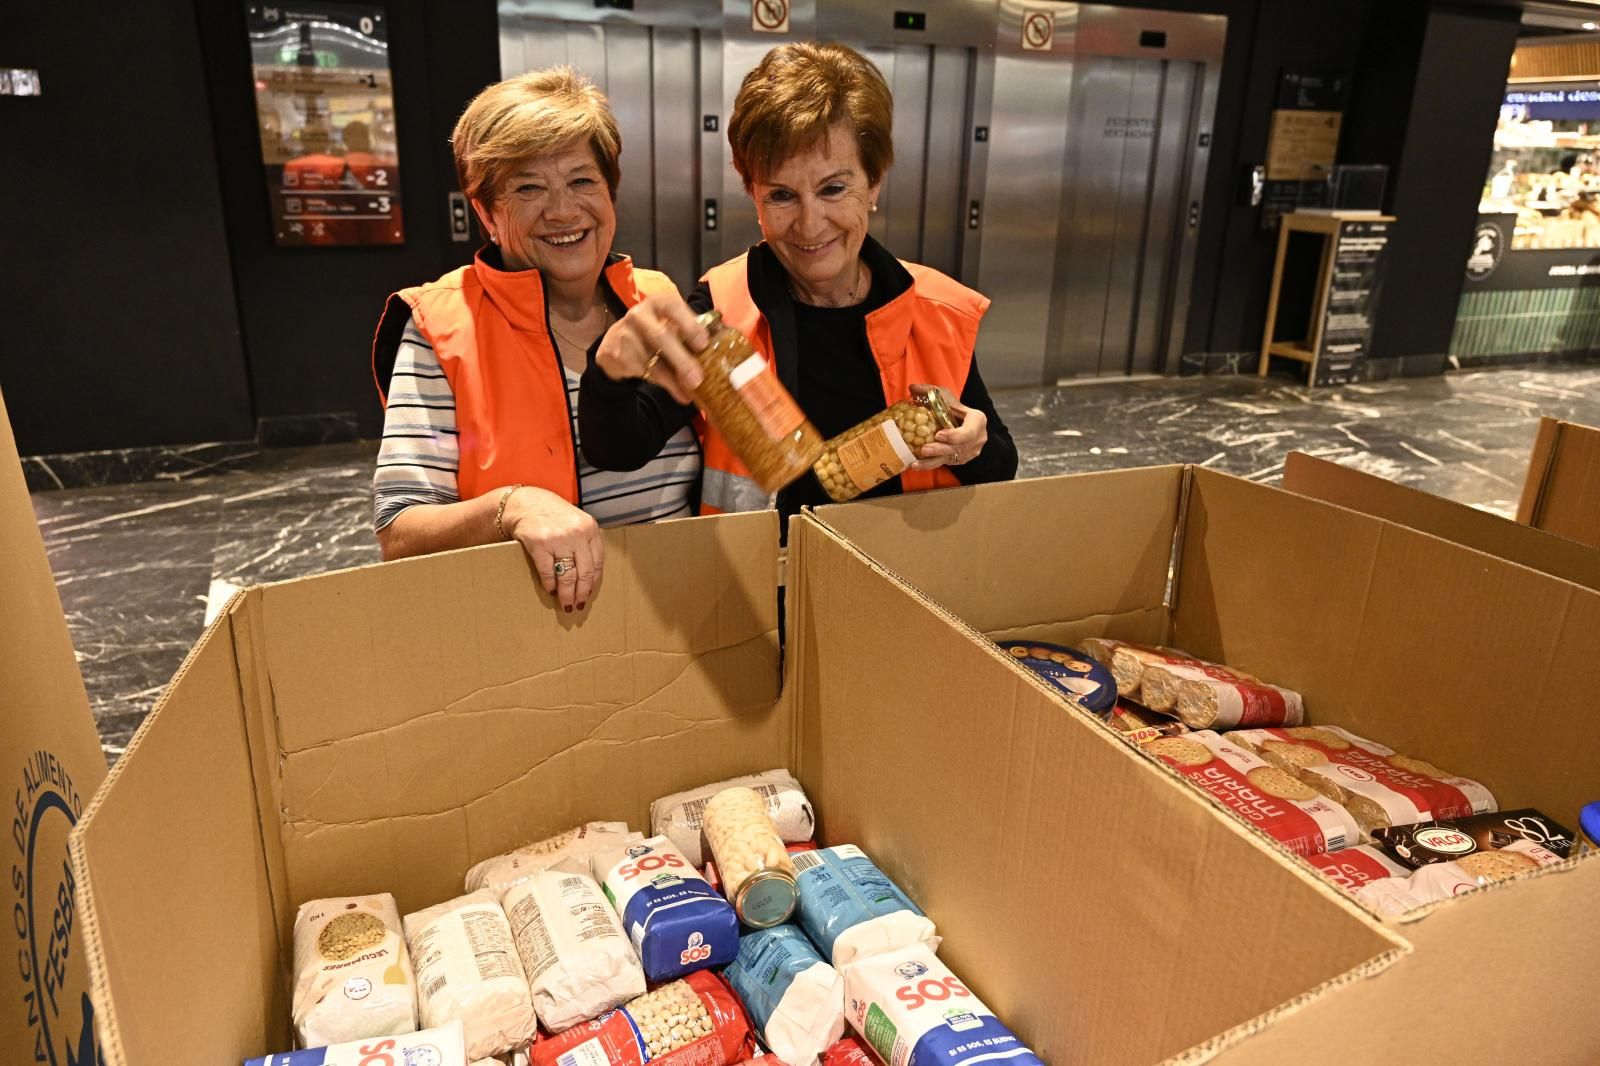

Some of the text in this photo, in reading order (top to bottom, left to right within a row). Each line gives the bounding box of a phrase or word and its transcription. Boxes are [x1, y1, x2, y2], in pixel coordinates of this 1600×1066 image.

[359, 16, 374, 34] 0
[359, 74, 378, 88] -1
[366, 170, 388, 186] -2
[368, 197, 391, 213] -3
[13, 789, 29, 857] DE
[24, 750, 83, 821] ALIMENTO
[1188, 771, 1266, 822] GALLETAS
[1421, 833, 1470, 848] VALOR
[1503, 816, 1564, 850] 82
[618, 853, 685, 882] SOS
[44, 842, 76, 1018] FESBA
[322, 949, 389, 971] LEGUMBRES
[681, 944, 712, 965] SOS
[895, 976, 971, 1010] SOS
[856, 999, 867, 1026] SOS
[358, 1039, 396, 1066] SO
[948, 1049, 956, 1057] SI
[956, 1046, 967, 1054] ES
[966, 1041, 984, 1052] SOS,
[992, 1035, 1016, 1046] BUENO
